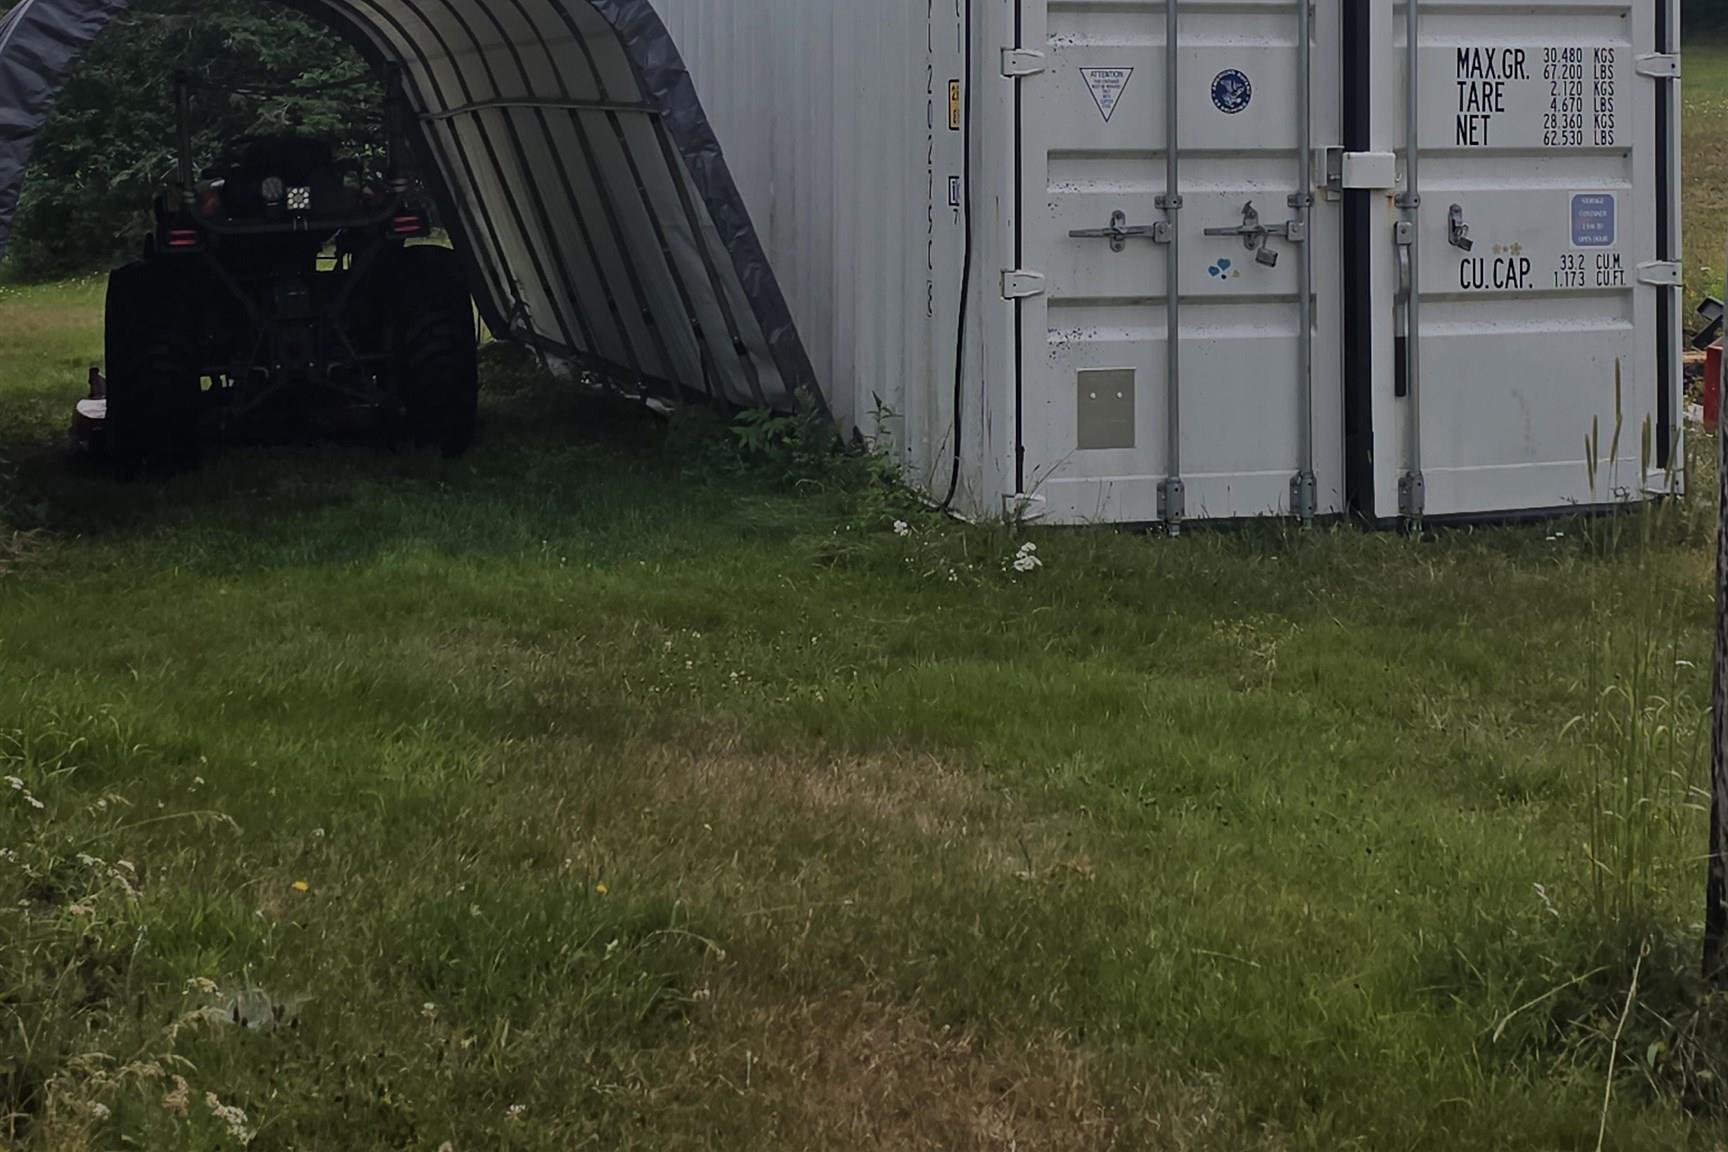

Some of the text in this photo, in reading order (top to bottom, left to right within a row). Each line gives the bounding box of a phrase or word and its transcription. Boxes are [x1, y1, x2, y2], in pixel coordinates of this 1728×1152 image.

[1456, 47, 1530, 80] MAX.GR.
[1543, 48, 1615, 63] 30.480 KGS
[1543, 64, 1614, 80] 67.200 LBS
[1456, 81, 1505, 112] TARE
[1550, 81, 1615, 96] 2.120 KGS
[1550, 97, 1614, 113] 4.670 LBS
[1543, 114, 1615, 129] 28.360 KGS
[1456, 114, 1491, 146] NET
[1543, 130, 1614, 146] 62.530 LBS
[1560, 254, 1585, 270] 33.2
[1554, 271, 1585, 287] 1.173
